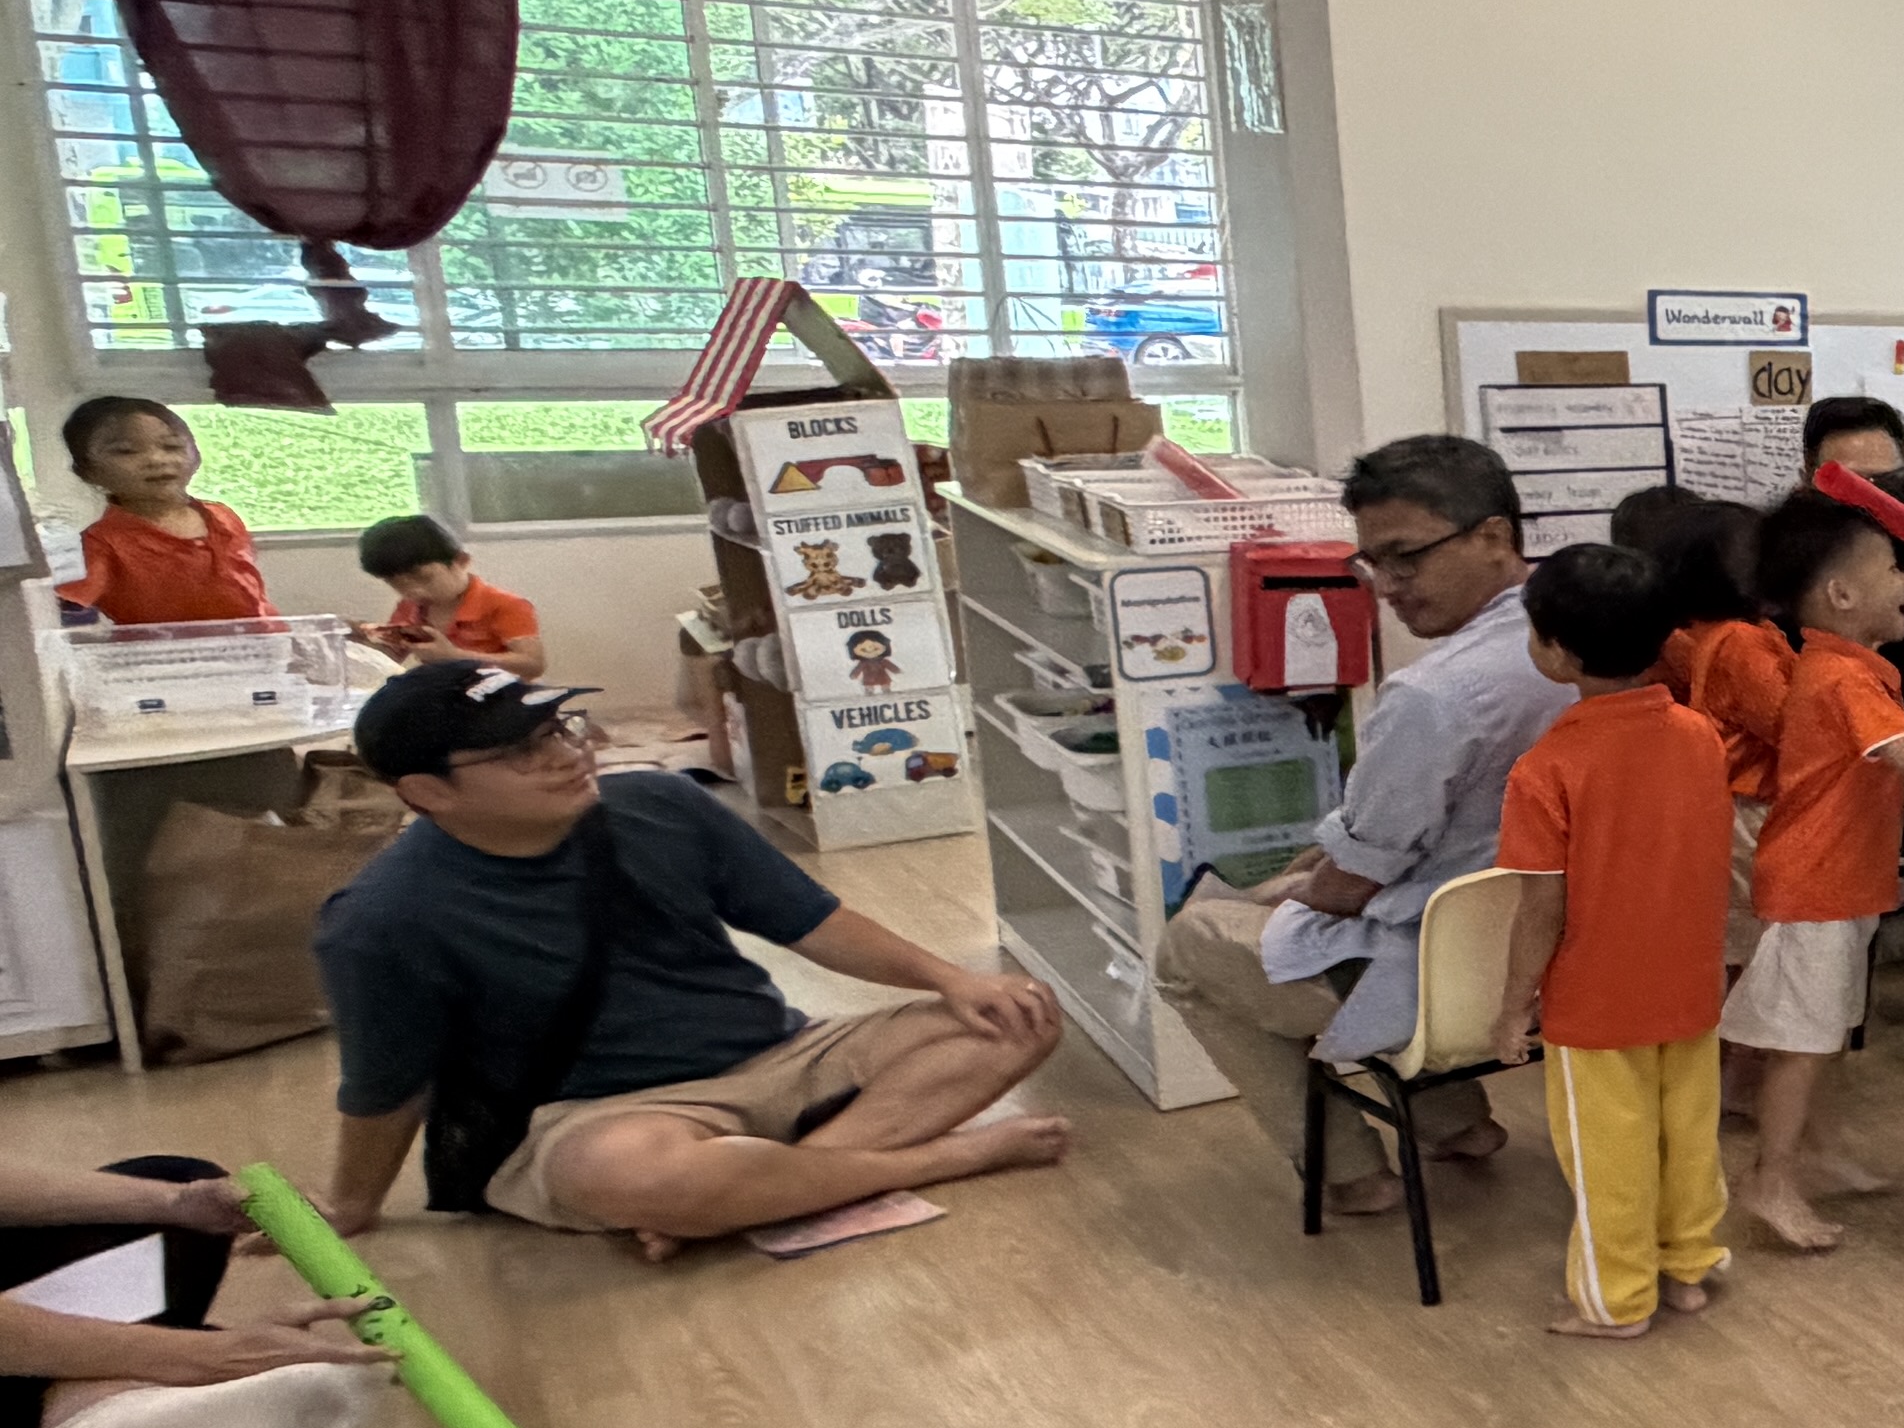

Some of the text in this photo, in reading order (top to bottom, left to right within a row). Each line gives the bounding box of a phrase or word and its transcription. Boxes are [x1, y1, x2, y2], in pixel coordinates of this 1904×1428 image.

[1665, 308, 1765, 326] Wonderwall
[787, 417, 858, 439] BLOCKS
[773, 508, 912, 535] STUFFED ANIMALS
[837, 608, 893, 628] DOLLS
[830, 700, 932, 729] VEHICLES
